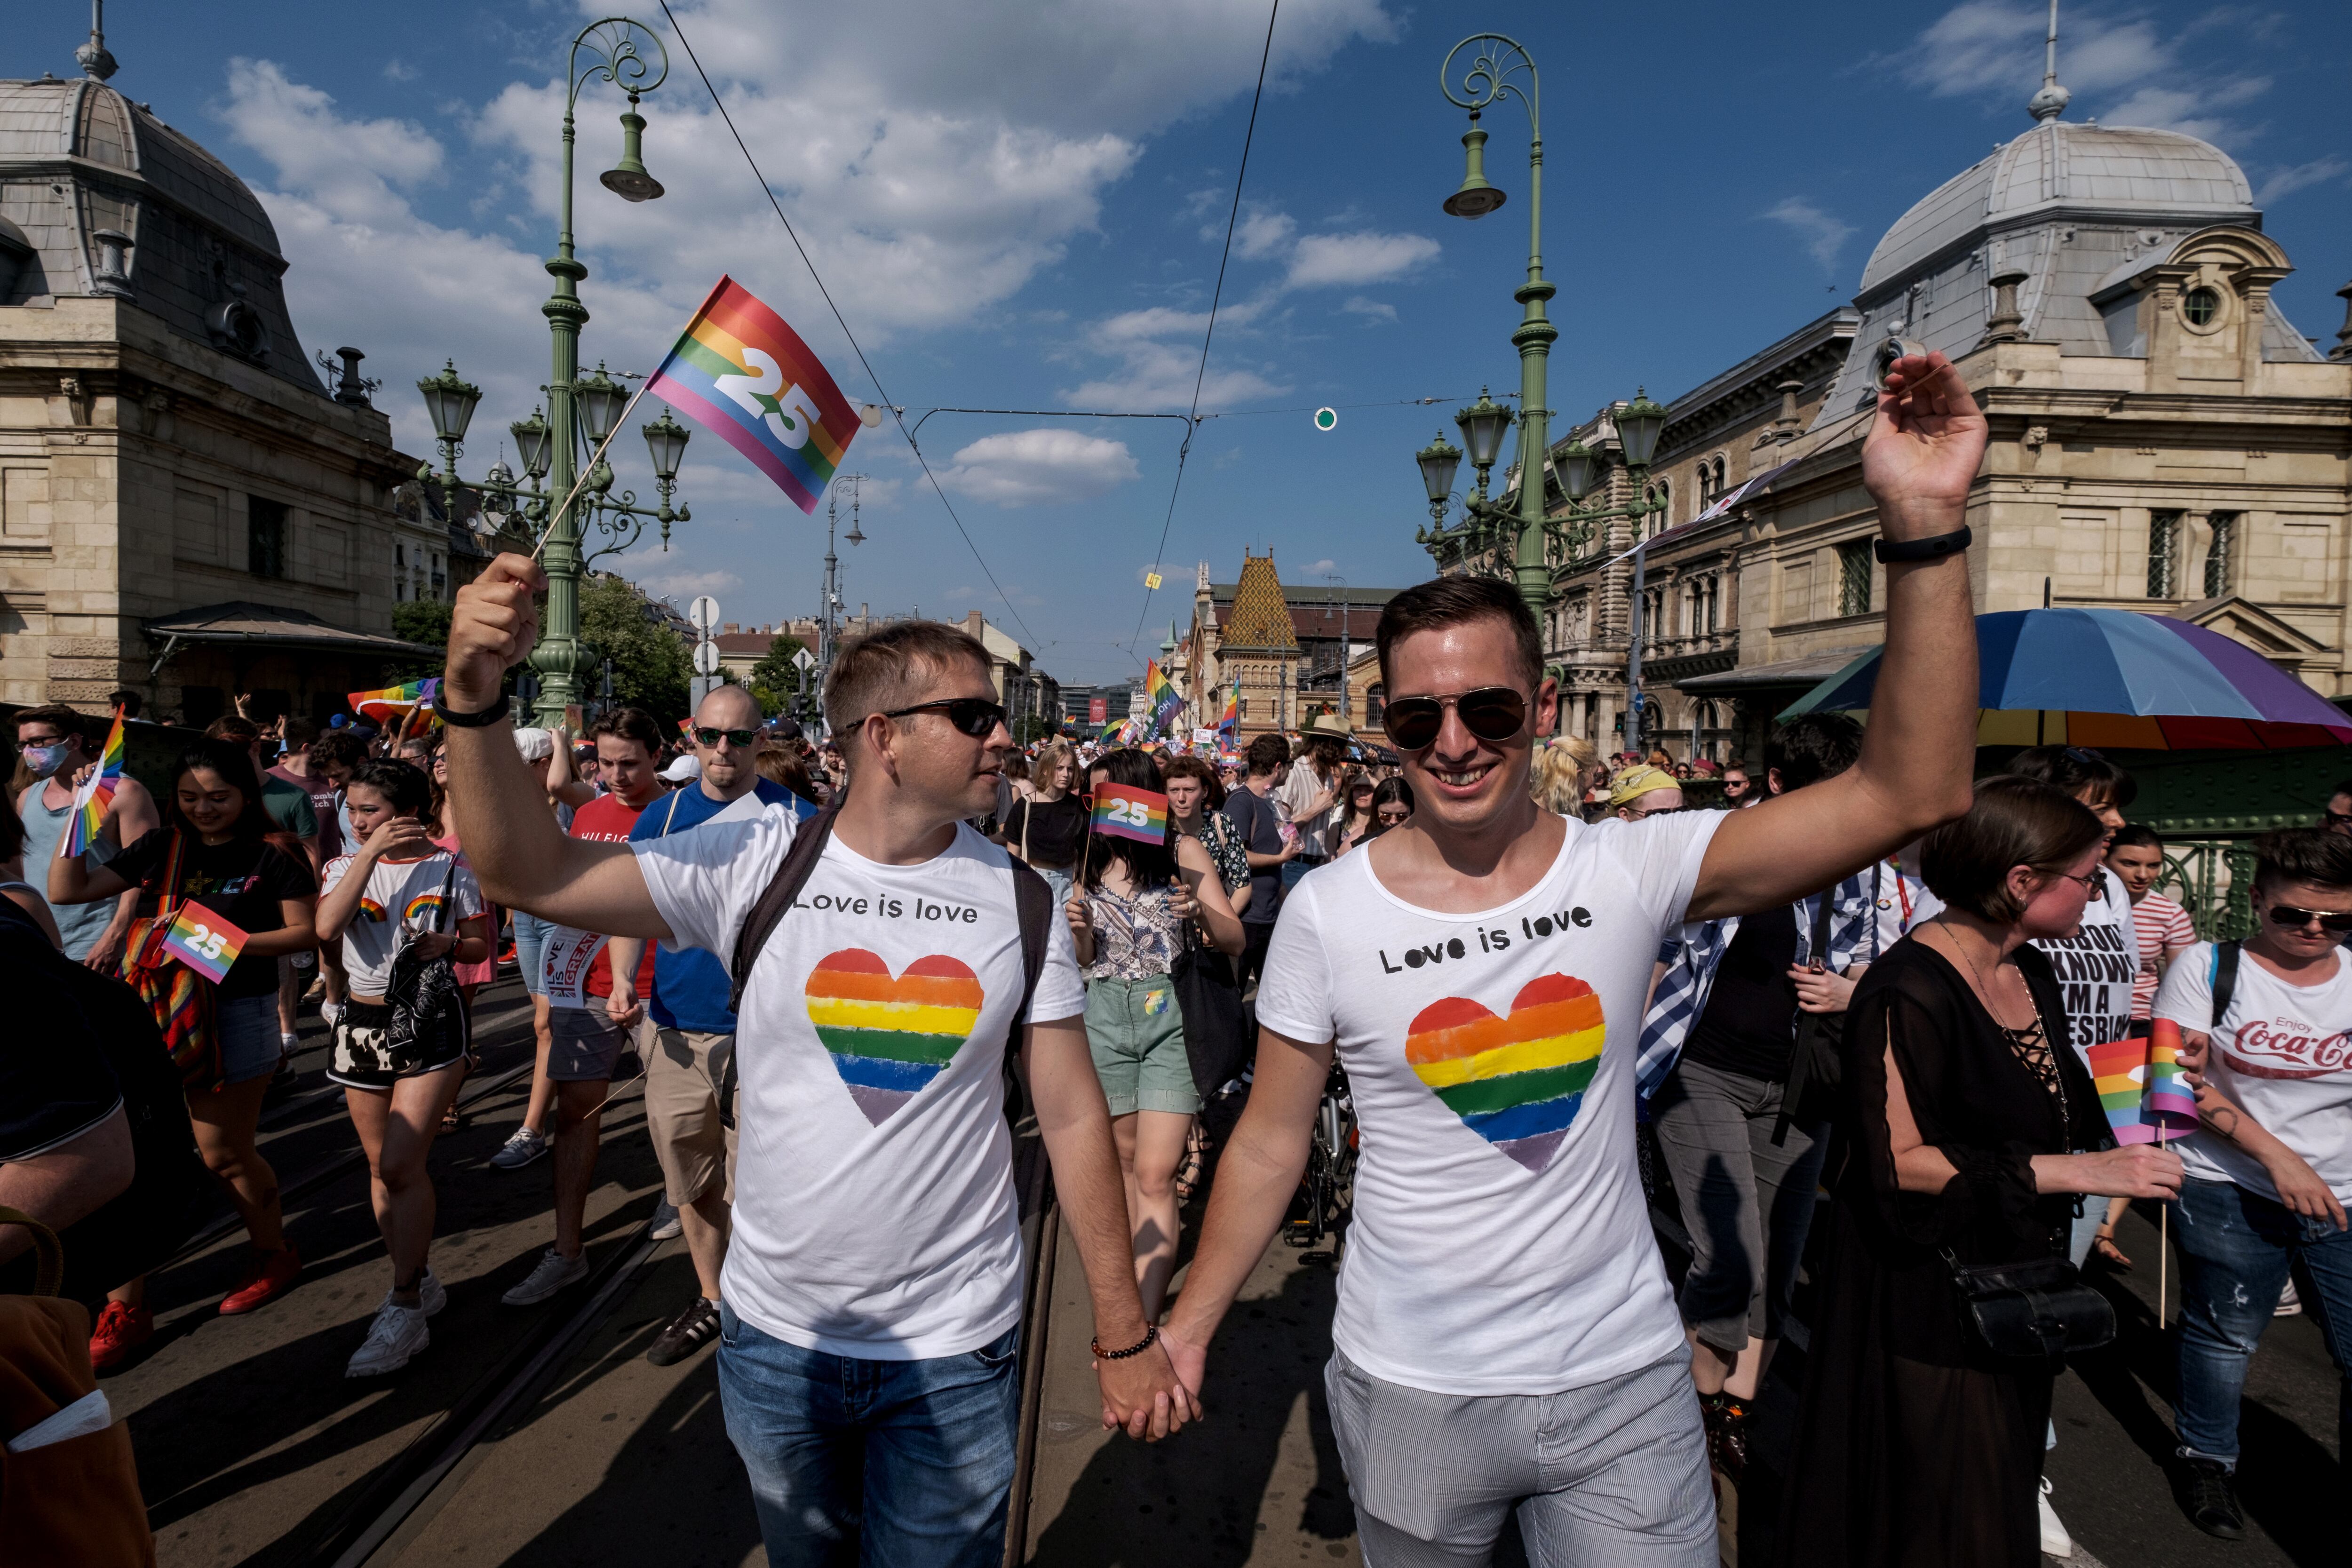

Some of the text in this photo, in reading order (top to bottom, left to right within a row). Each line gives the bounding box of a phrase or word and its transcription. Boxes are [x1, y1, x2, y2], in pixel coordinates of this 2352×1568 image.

[713, 348, 822, 449] 25
[1107, 798, 1149, 827] 25
[793, 893, 978, 923] Love is love
[183, 924, 228, 959] 25
[1379, 907, 1592, 974] Love is love
[565, 934, 596, 983] GREAT
[581, 948, 595, 968] BRITAIN
[555, 971, 564, 985] IS
[2095, 984, 2109, 1014] A
[2067, 1014, 2131, 1046] ESBIAN
[2275, 1016, 2312, 1033] Enjoy
